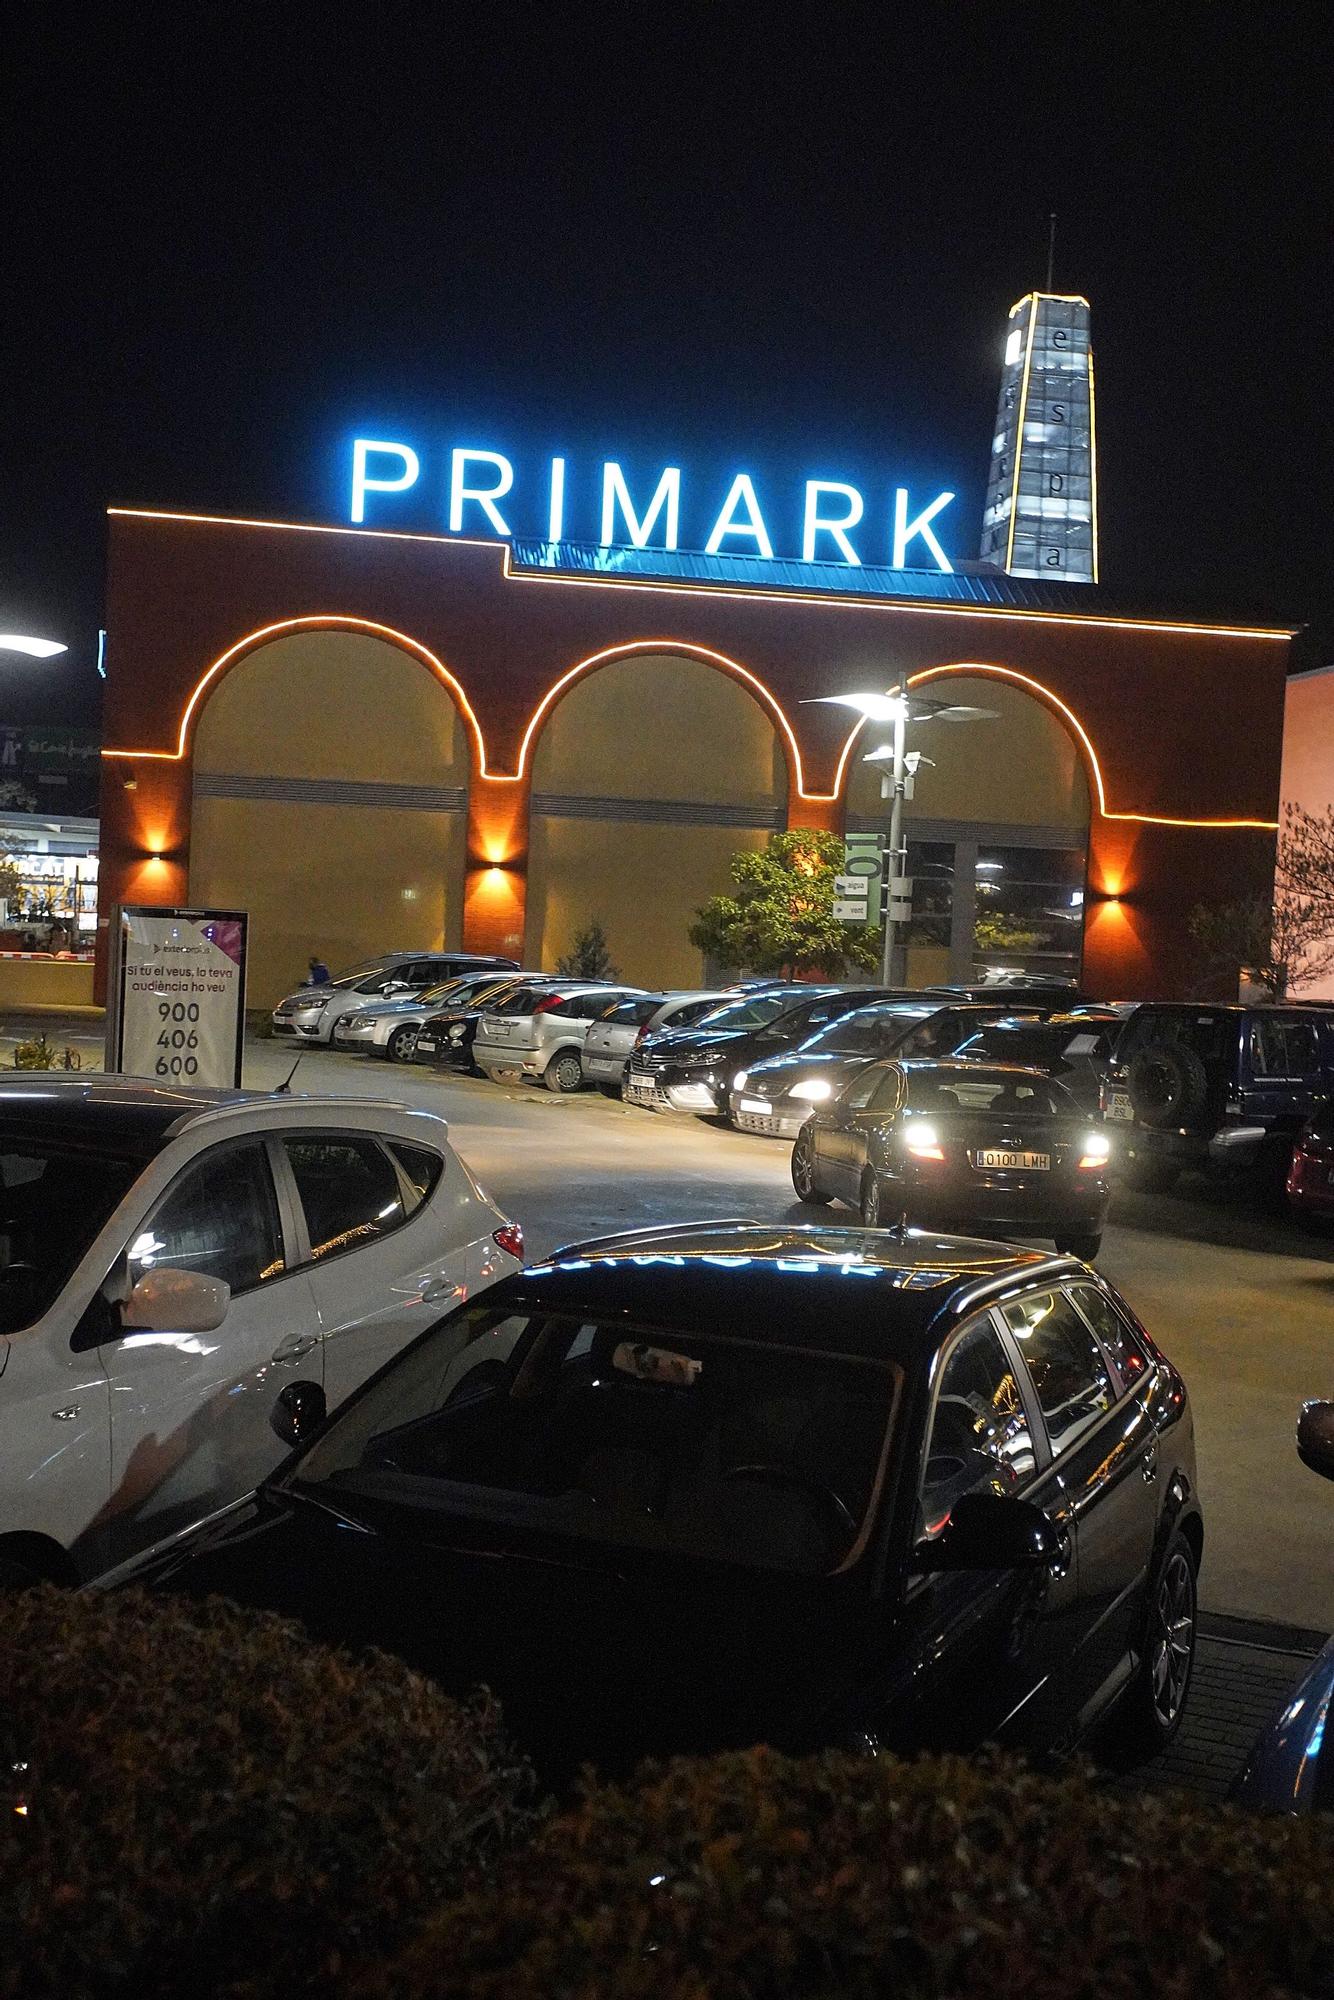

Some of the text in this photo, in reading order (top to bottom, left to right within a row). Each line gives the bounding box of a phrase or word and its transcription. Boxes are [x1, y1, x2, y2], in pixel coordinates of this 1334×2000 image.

[350, 438, 955, 574] PRIMARK
[140, 966, 152, 977] tu
[154, 966, 165, 977] el
[167, 968, 194, 979] veus,
[196, 968, 207, 978] la
[207, 969, 233, 979] teva
[132, 981, 226, 993] audiència ho veu
[158, 1002, 200, 1023] 900
[156, 1029, 199, 1049] 406
[155, 1055, 199, 1076] 600
[986, 1153, 1047, 1168] 0100 LMH
